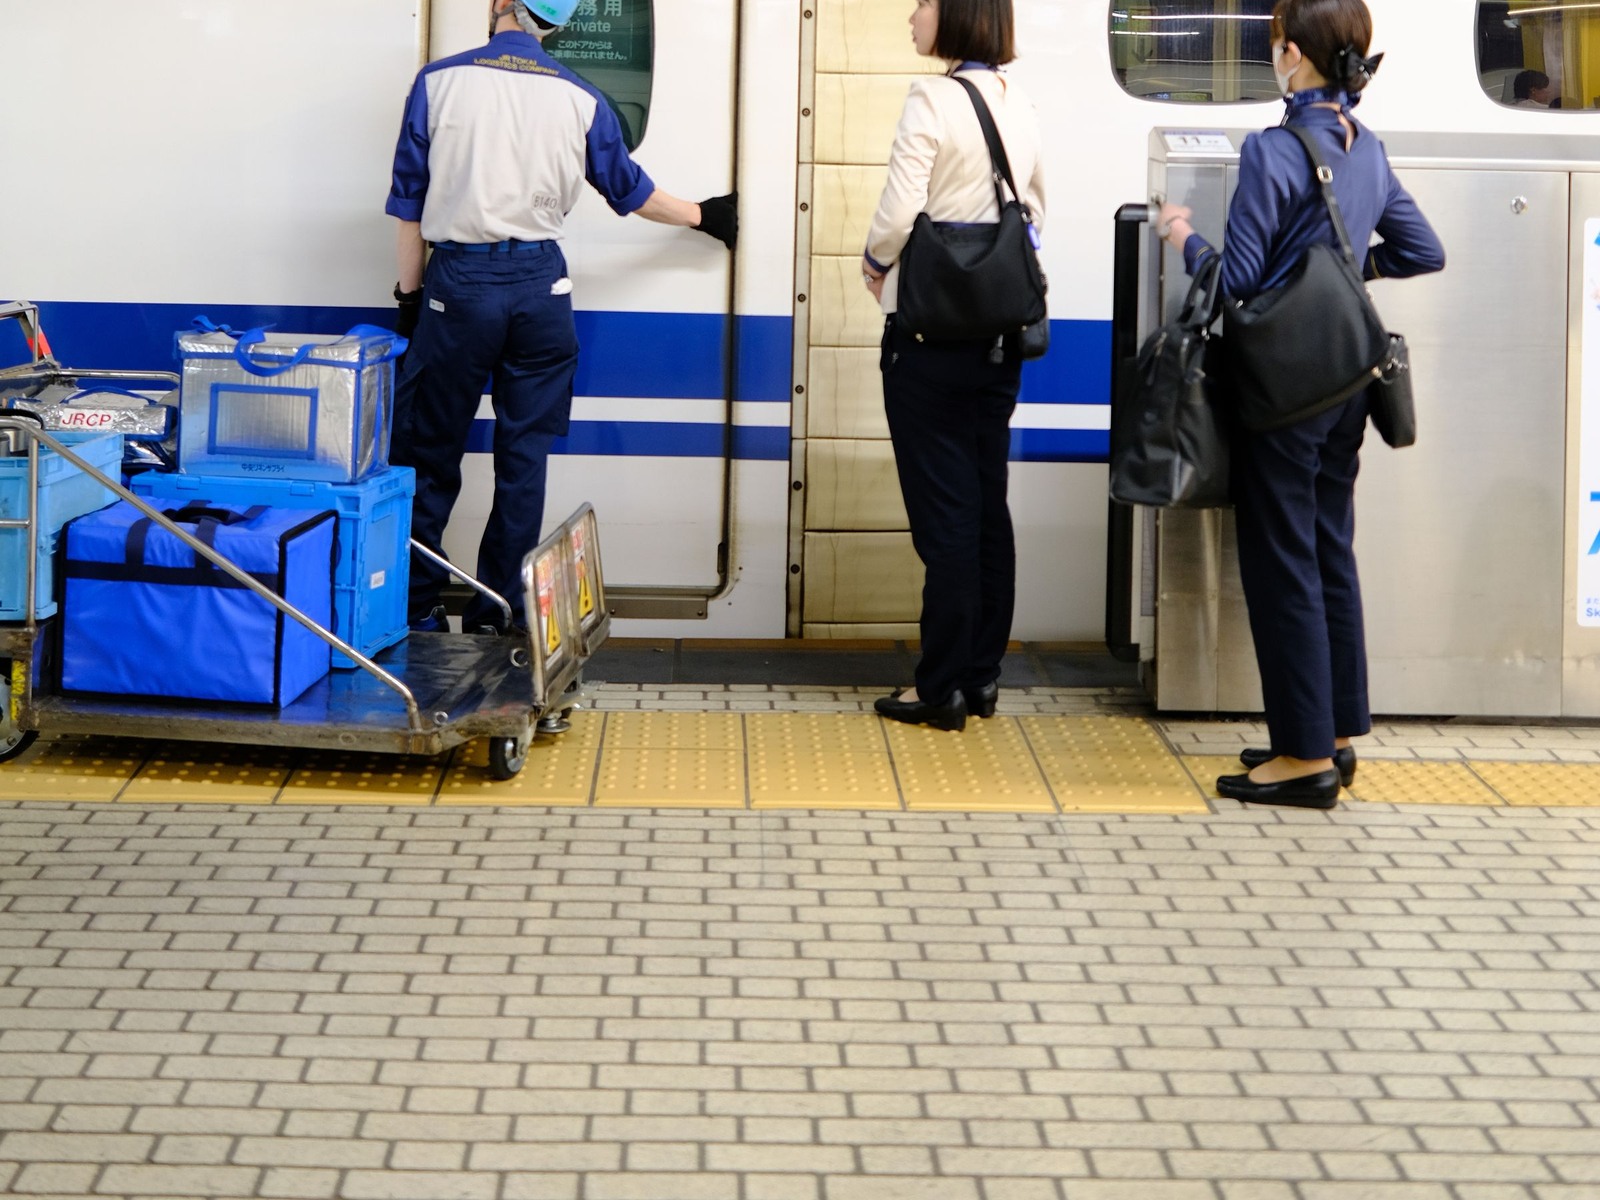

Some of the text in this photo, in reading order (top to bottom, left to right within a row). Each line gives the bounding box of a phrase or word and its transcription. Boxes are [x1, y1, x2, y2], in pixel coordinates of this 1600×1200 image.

[558, 40, 613, 50] このドアからは
[62, 413, 111, 426] JRCP
